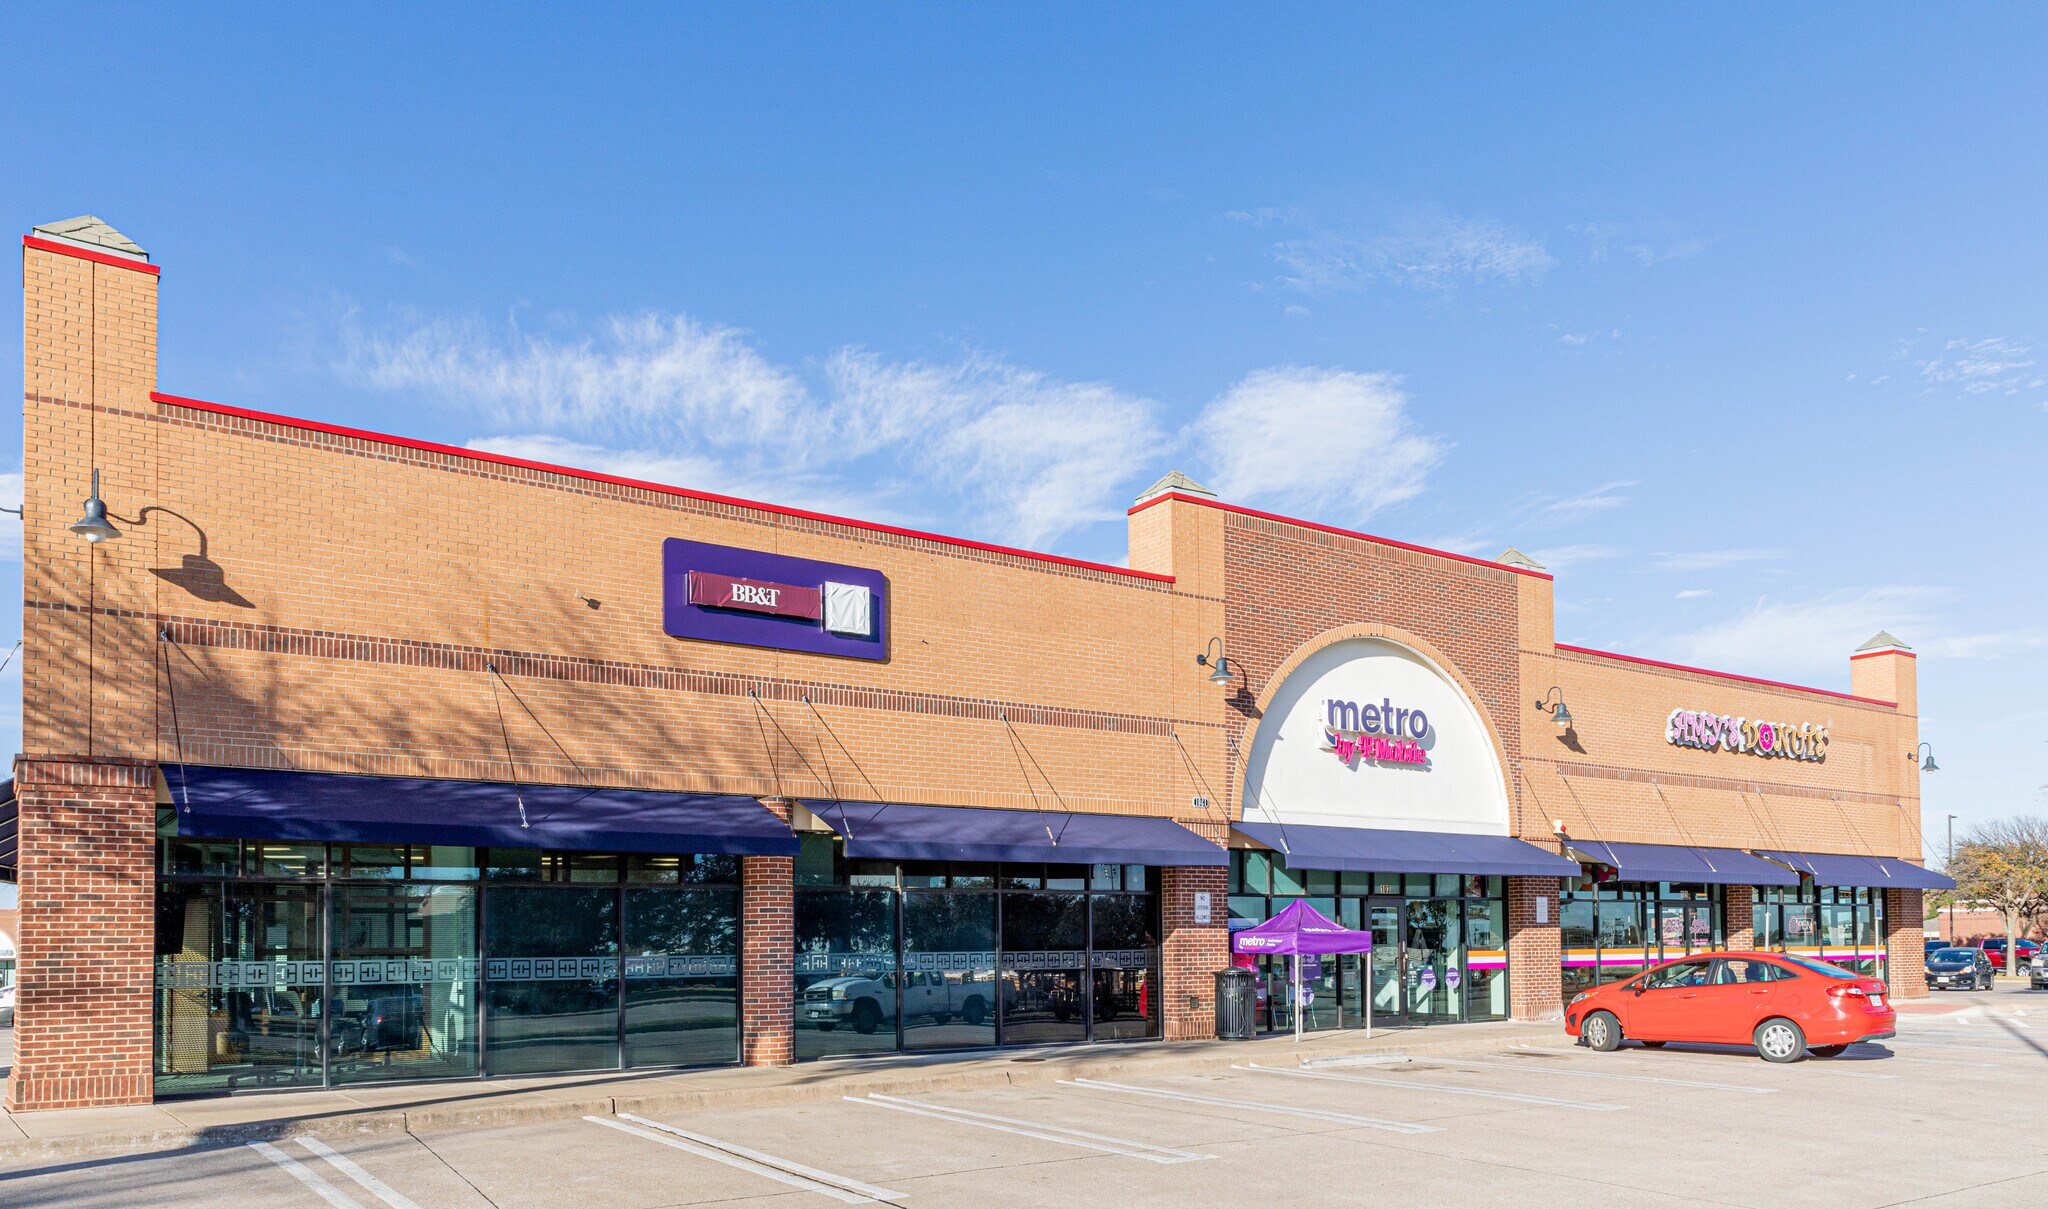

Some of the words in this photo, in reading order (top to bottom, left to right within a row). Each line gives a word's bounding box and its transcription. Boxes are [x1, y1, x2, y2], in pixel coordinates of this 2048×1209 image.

[730, 583, 780, 607] BB&T
[1327, 697, 1429, 740] metro
[1333, 733, 1357, 763] by
[1672, 710, 1739, 748] AMY'S
[1743, 718, 1828, 758] DONUTS
[1239, 935, 1265, 948] metro
